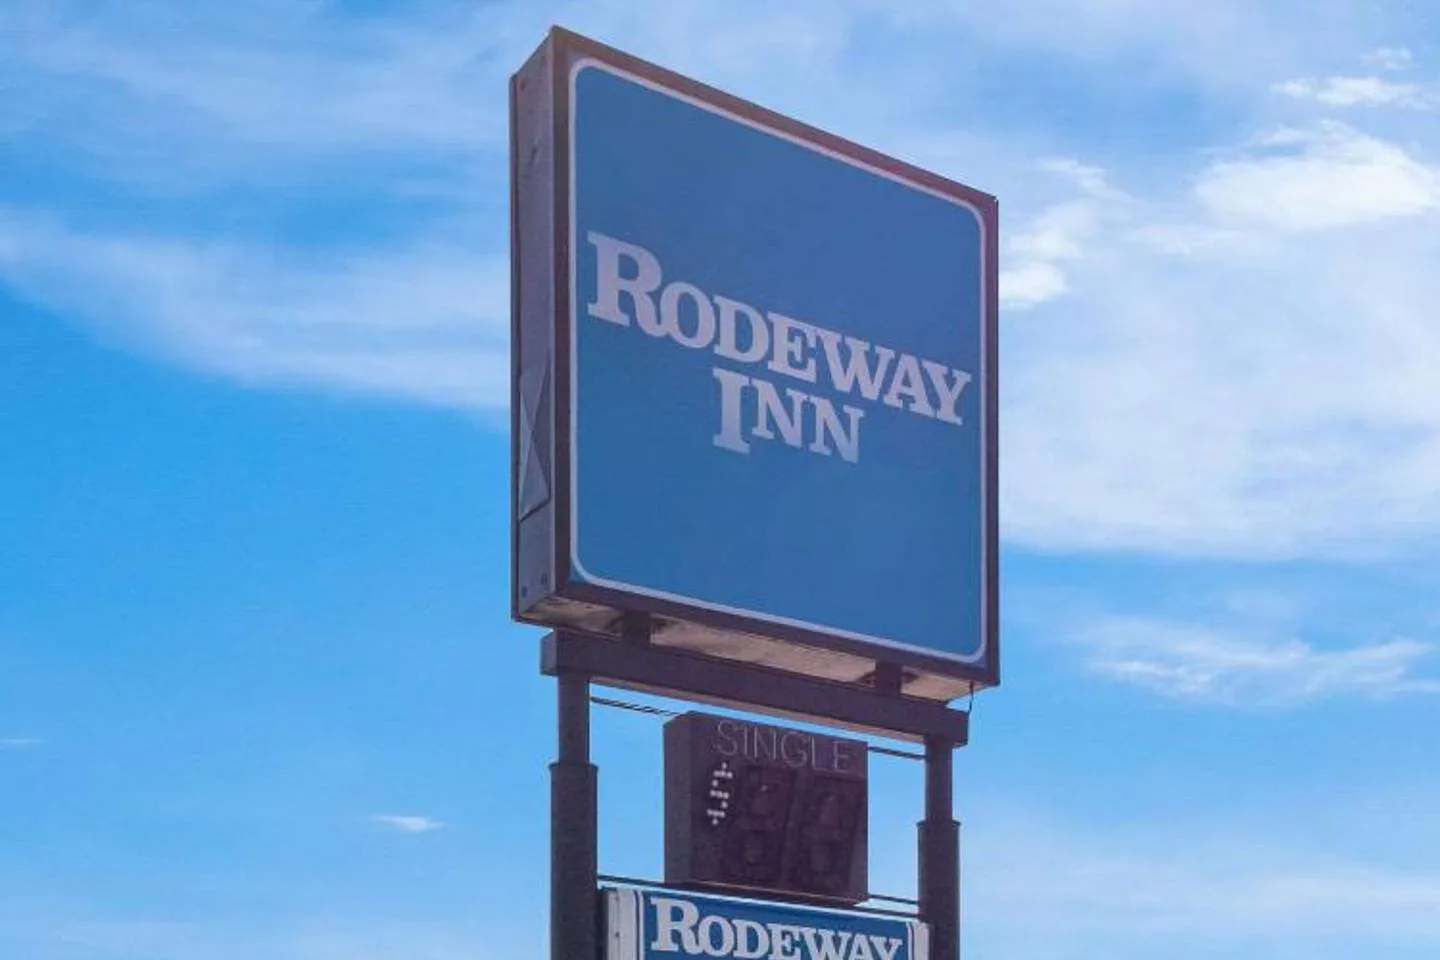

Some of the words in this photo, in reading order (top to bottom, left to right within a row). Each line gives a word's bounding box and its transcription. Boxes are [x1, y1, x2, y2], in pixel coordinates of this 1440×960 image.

[588, 233, 971, 425] RODEWAY
[713, 369, 864, 464] INN
[716, 720, 850, 773] SINGLE
